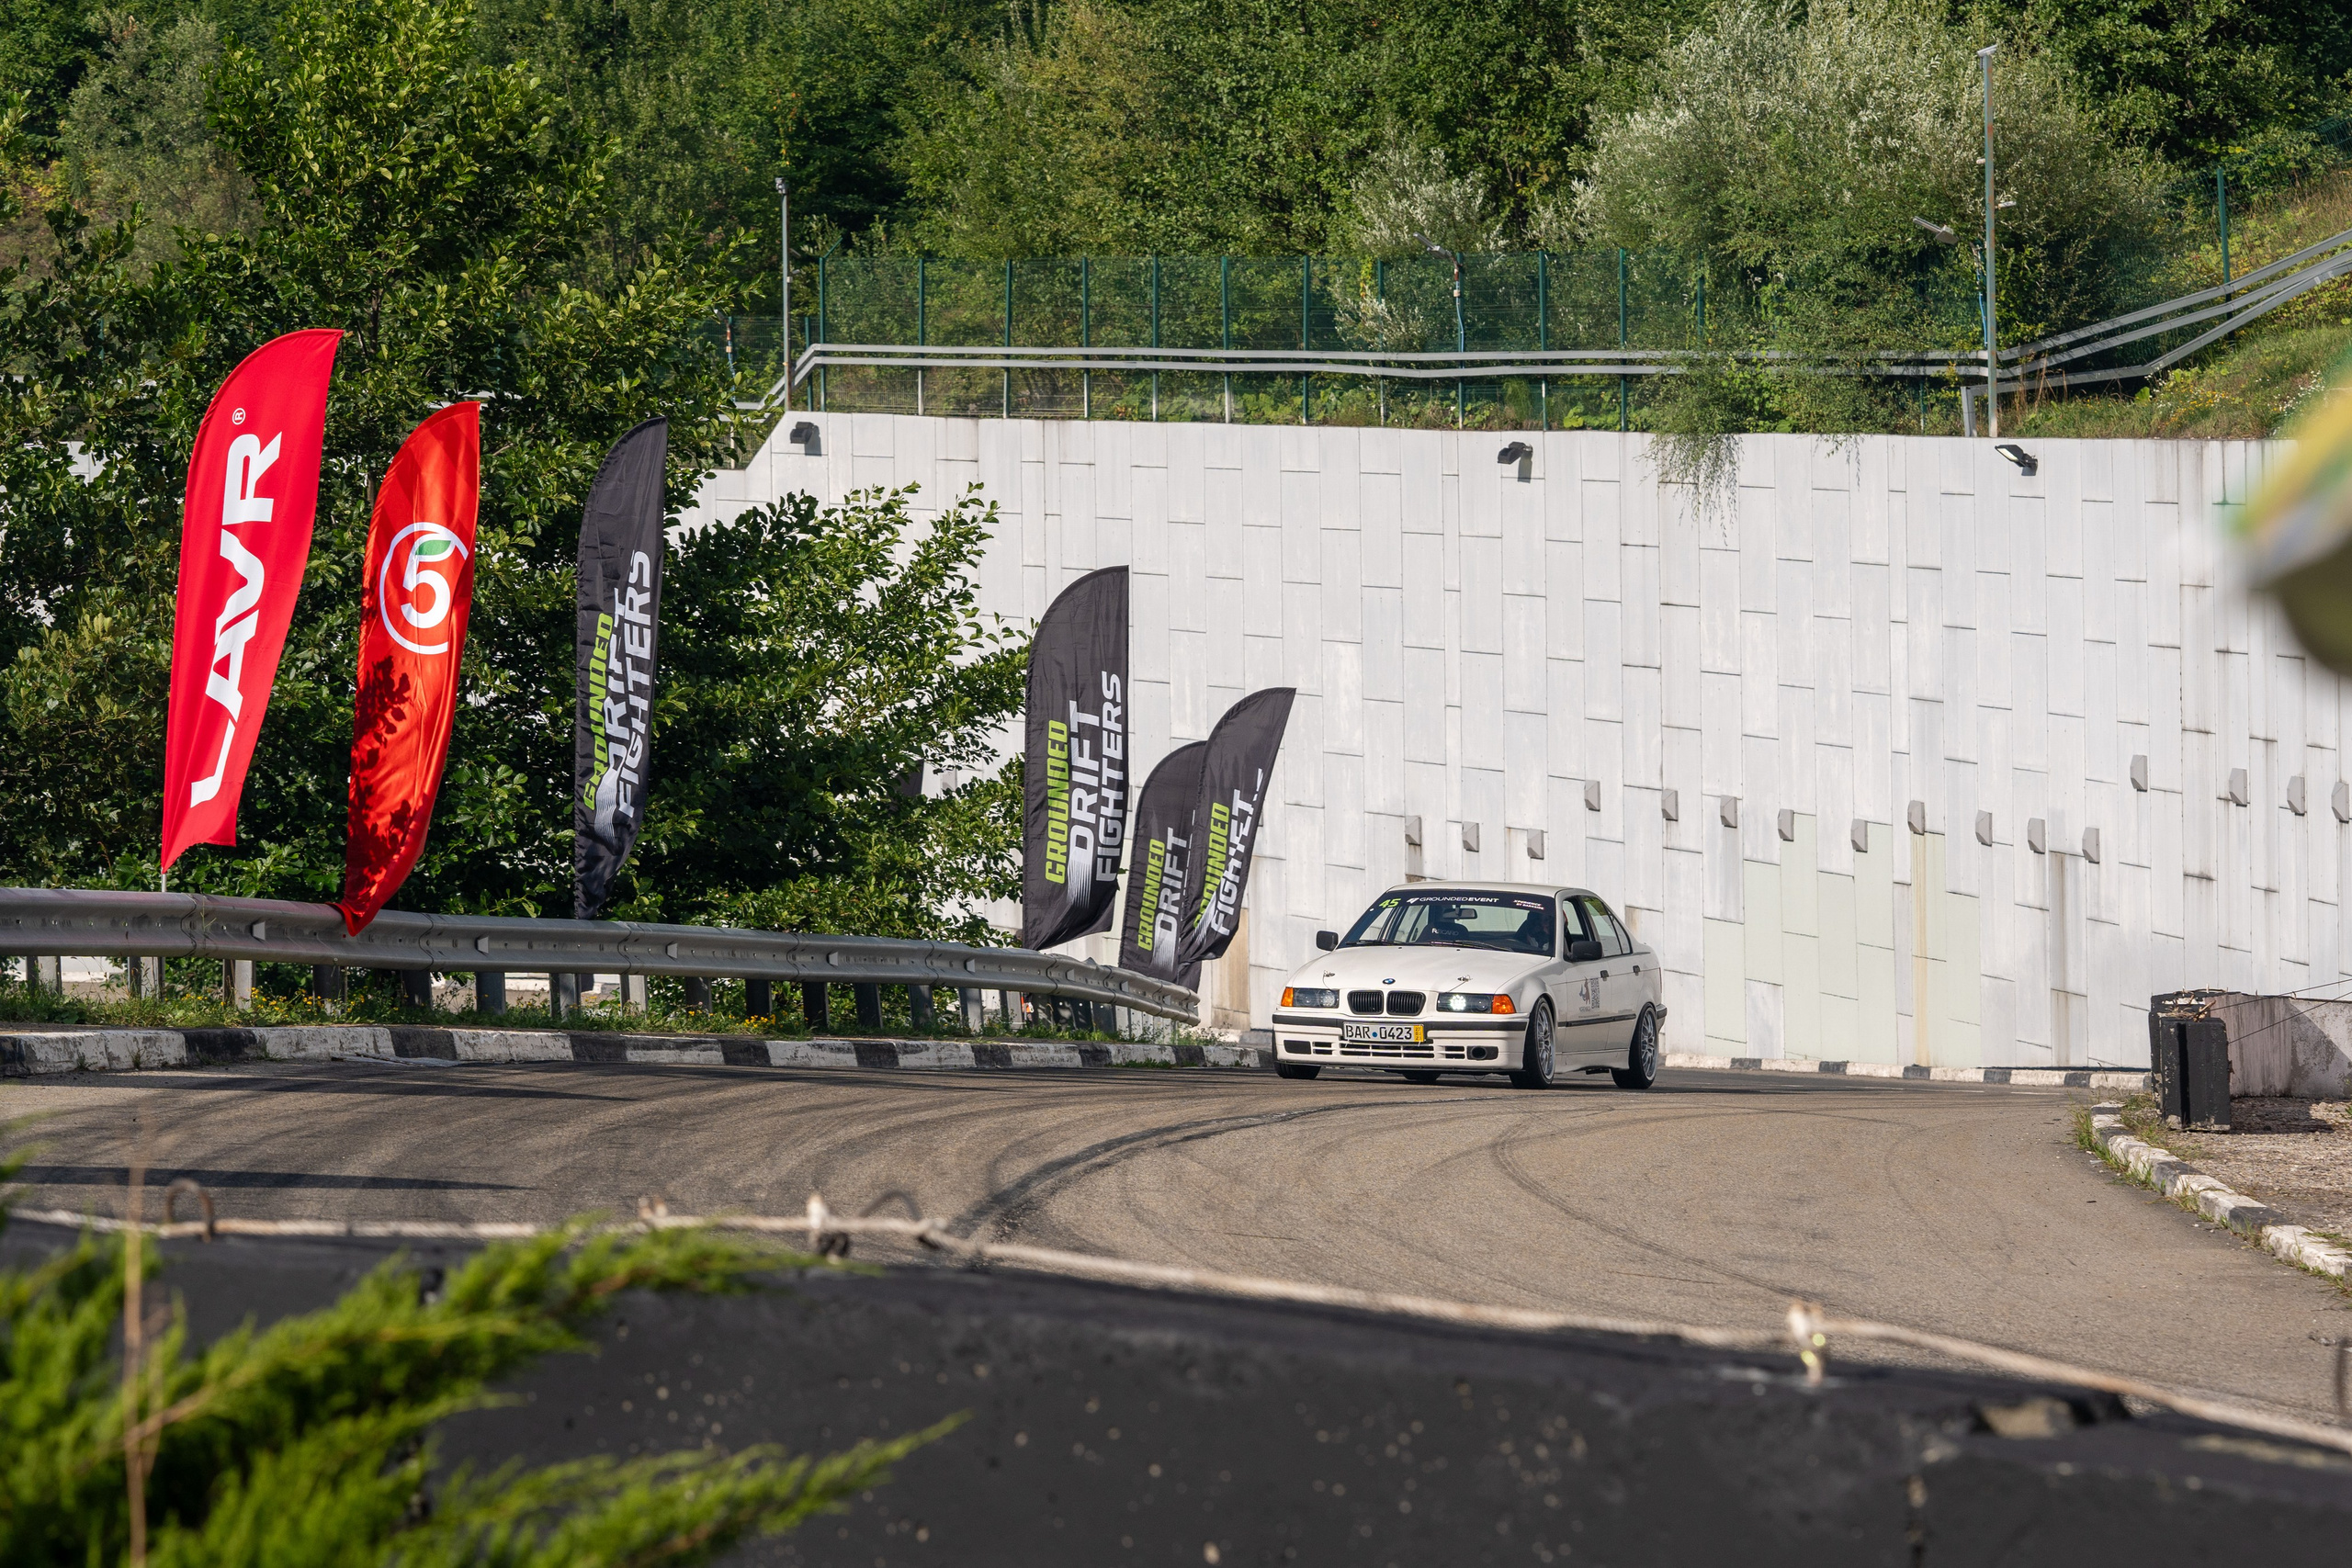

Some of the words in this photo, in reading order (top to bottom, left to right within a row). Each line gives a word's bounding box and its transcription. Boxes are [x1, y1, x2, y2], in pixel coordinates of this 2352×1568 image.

[190, 432, 282, 808] LAVR
[401, 533, 457, 629] 5
[583, 613, 614, 810] GROUNDED
[618, 550, 651, 818] FIGHTERS
[1045, 719, 1069, 884] GROUNDED
[1067, 700, 1100, 871] DRIFT
[1096, 670, 1124, 882] FIGHTERS
[1137, 839, 1166, 952] GROUNDED
[1154, 827, 1187, 948] DRIFT
[1379, 897, 1401, 908] 45
[1345, 1025, 1371, 1039] BAR
[1379, 1026, 1412, 1040] 0423
